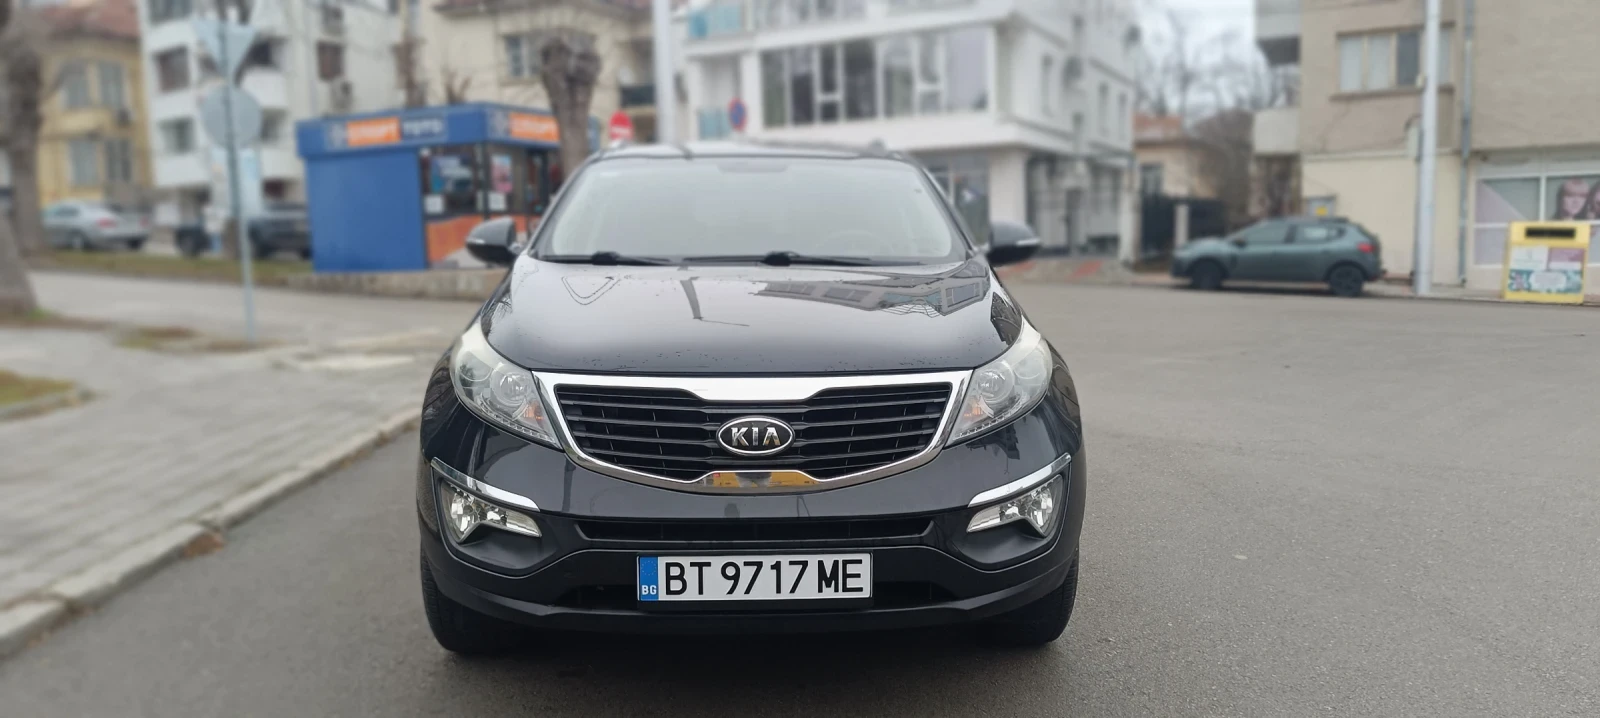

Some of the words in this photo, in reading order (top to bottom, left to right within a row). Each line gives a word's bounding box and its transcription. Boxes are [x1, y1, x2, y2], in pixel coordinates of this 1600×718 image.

[731, 427, 781, 447] KIA
[665, 561, 711, 596] BT
[720, 560, 808, 595] 9717
[817, 559, 864, 593] ME
[641, 585, 657, 595] BG
